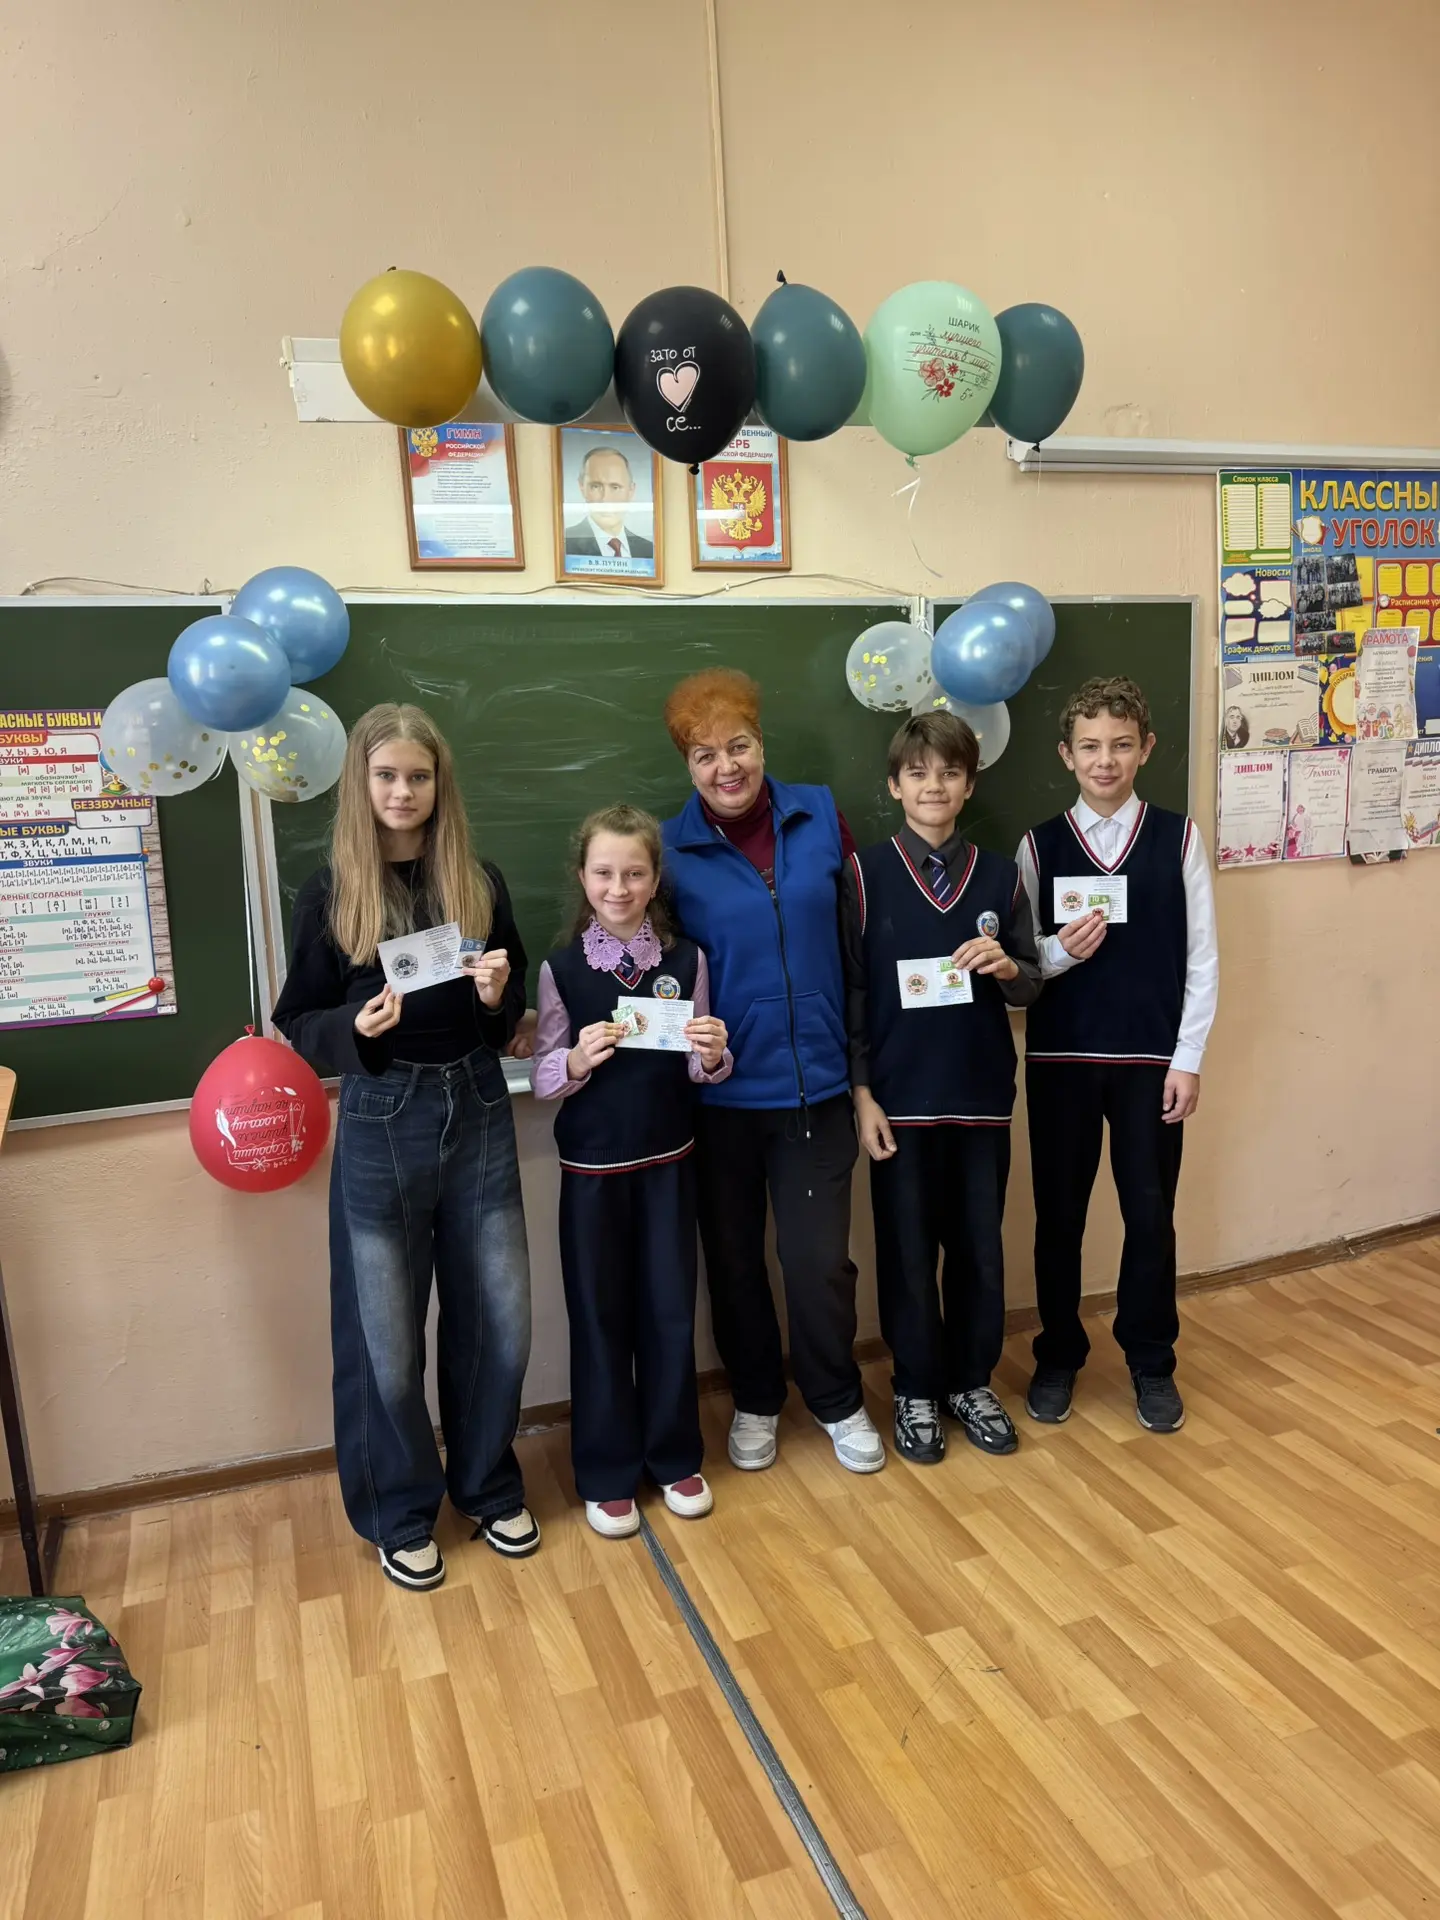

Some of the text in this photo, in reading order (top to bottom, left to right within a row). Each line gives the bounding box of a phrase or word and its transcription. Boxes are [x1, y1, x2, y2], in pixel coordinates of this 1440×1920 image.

[948, 317, 981, 333] ШАРИК
[446, 428, 482, 439] ГИМН
[728, 439, 750, 449] ЕРБ
[1232, 475, 1256, 483] Список
[1300, 480, 1438, 511] КЛАССНЫ
[1330, 518, 1436, 547] УГОЛОК
[1255, 568, 1291, 578] Новости
[1391, 598, 1429, 607] Расписание
[1363, 632, 1409, 646] ГРАМОТА
[1224, 644, 1291, 655] График дежурств
[1249, 671, 1294, 683] ДИПЛОМ
[46, 711, 91, 727] БУКВЫ
[94, 711, 102, 726] И
[1234, 763, 1273, 775] ДИПЛОМ
[1367, 766, 1398, 775] ГРАМОТА
[73, 798, 152, 810] БЕЗЗВУЧНЫЕ
[22, 824, 66, 836] БУКВЫ
[22, 859, 54, 868] ЗВУКИ
[32, 890, 83, 899] СОГЛАСНЫЕ
